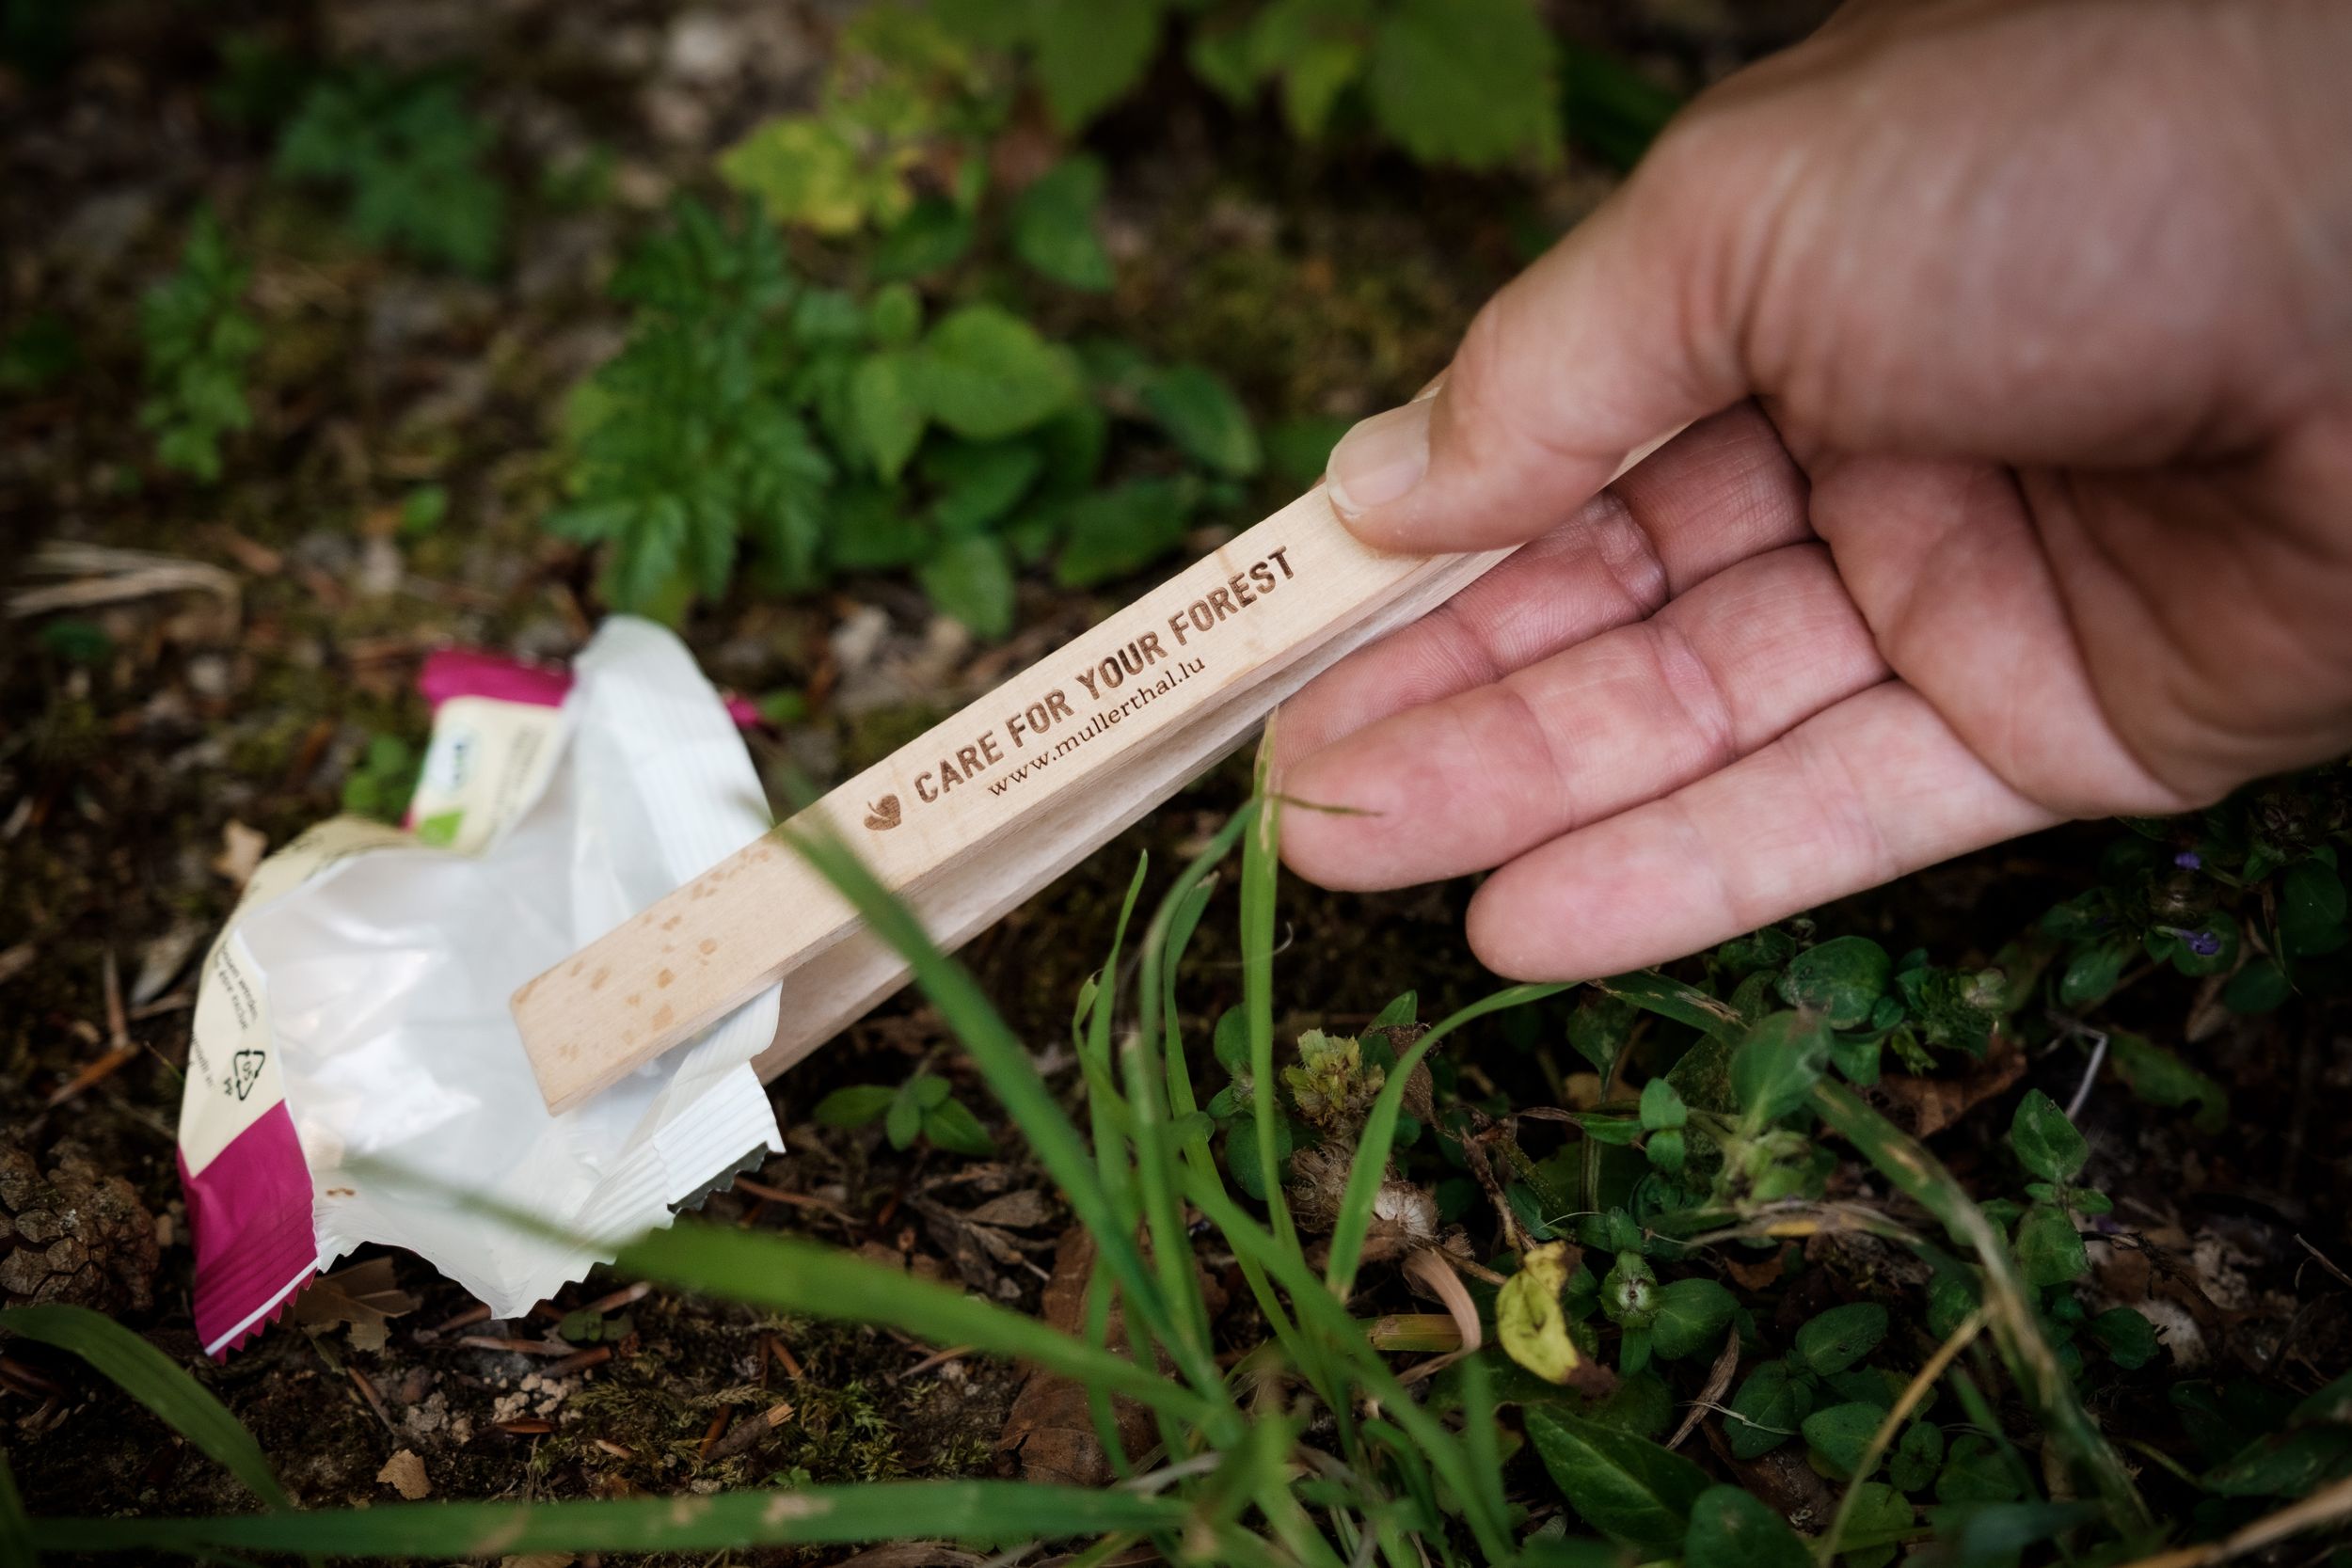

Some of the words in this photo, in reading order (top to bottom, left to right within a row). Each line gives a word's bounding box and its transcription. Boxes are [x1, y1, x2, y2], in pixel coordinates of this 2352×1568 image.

[914, 730, 1004, 802] CARE
[1006, 689, 1074, 748] FOR
[1075, 631, 1168, 700] YOUR
[1168, 546, 1294, 645] FOREST
[988, 657, 1205, 796] www.mullerthal.lu
